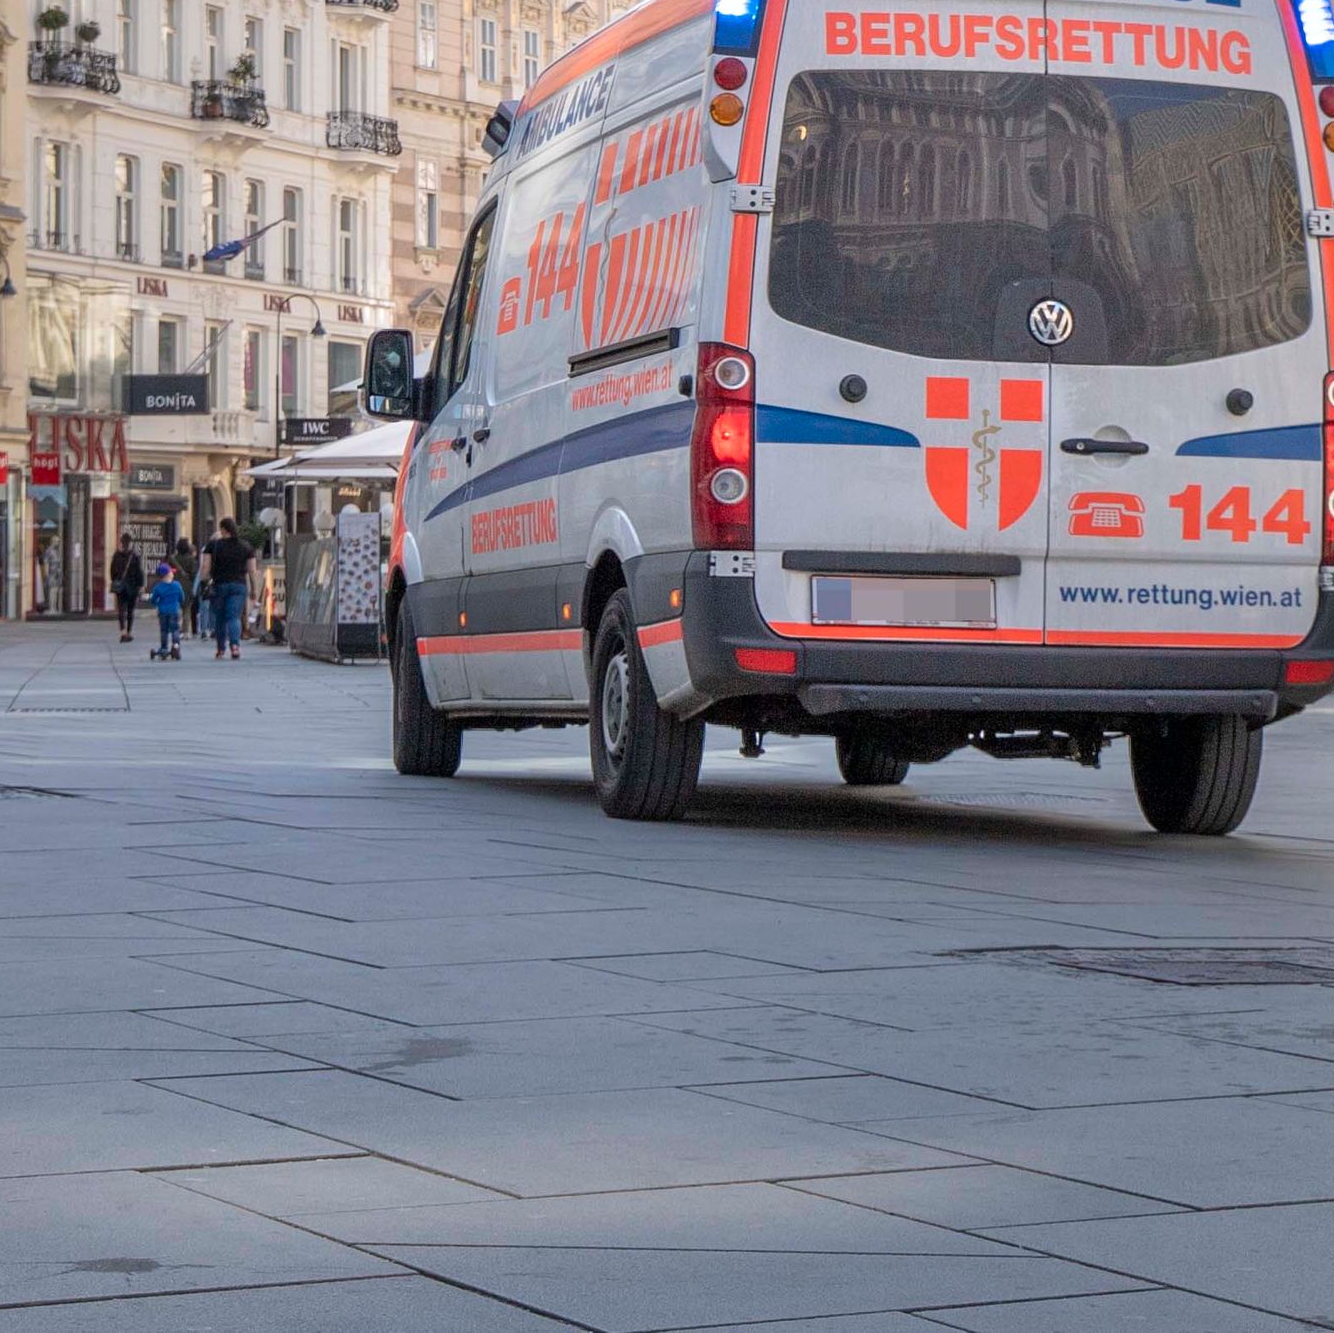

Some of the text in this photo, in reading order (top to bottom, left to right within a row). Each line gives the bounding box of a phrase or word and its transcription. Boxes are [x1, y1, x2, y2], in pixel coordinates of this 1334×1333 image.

[825, 11, 1253, 75] BERUFSRETTUNG
[515, 64, 616, 161] AMBULANCE
[524, 201, 587, 327] 144
[137, 277, 169, 298] LISKA
[263, 294, 292, 314] LISKA
[338, 304, 364, 324] LISKA
[571, 359, 674, 411] www.rettung.wien.at
[302, 421, 330, 435] IWC
[34, 457, 59, 471] högl
[471, 497, 558, 555] BERUFSRETTUNG
[1168, 484, 1312, 545] 144
[1059, 584, 1303, 611] www.rettung.wien.at
